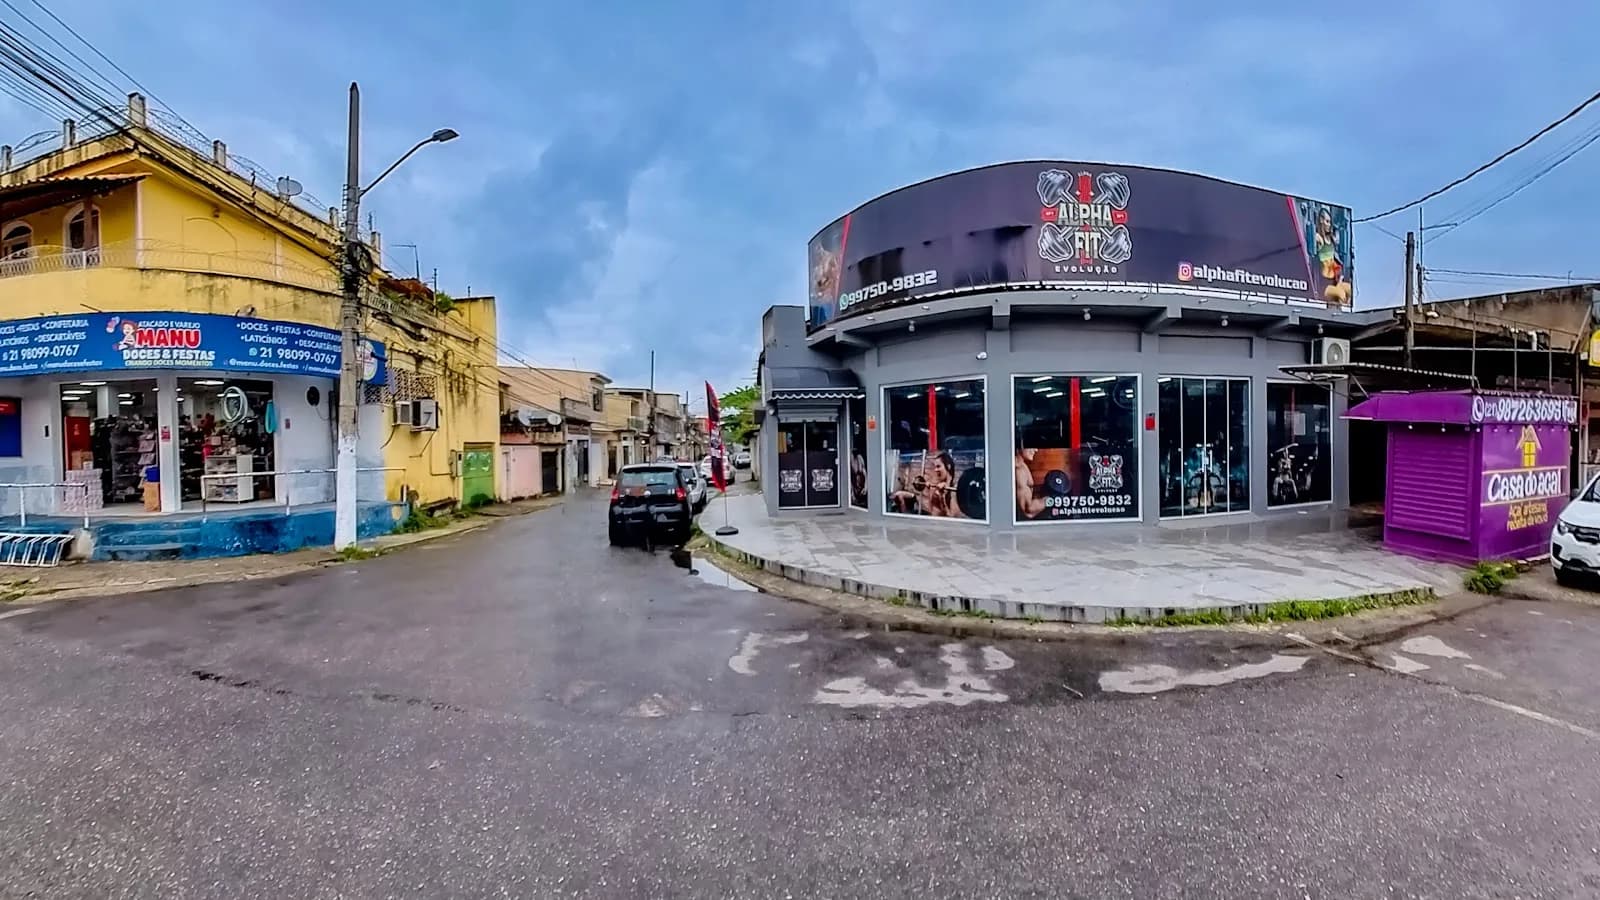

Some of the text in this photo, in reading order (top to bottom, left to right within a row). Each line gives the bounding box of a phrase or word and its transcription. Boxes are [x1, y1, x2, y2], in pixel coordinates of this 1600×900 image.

[1058, 203, 1113, 227] ALPHA
[1074, 231, 1101, 259] FIT
[1055, 265, 1118, 274] EVOLUÇÃO
[1193, 264, 1308, 291] alphafitevolucao
[848, 270, 937, 306] 99750-9832
[138, 320, 168, 328] ATACADO
[174, 321, 201, 329] VAREJO
[241, 322, 268, 331] DOCES
[275, 325, 301, 335] FESTAS
[136, 329, 201, 349] MANU
[244, 334, 288, 345] LATICÍNIOS
[9, 344, 80, 361] 21 98099-0767
[123, 349, 216, 360] DOCES & FESTAS
[260, 347, 337, 364] 21 98099-0767
[1096, 467, 1116, 476] ALPHA
[1102, 477, 1112, 487] FIT
[1488, 473, 1524, 502] Casa
[1525, 470, 1537, 496] do
[1054, 494, 1132, 507] 99750-9832
